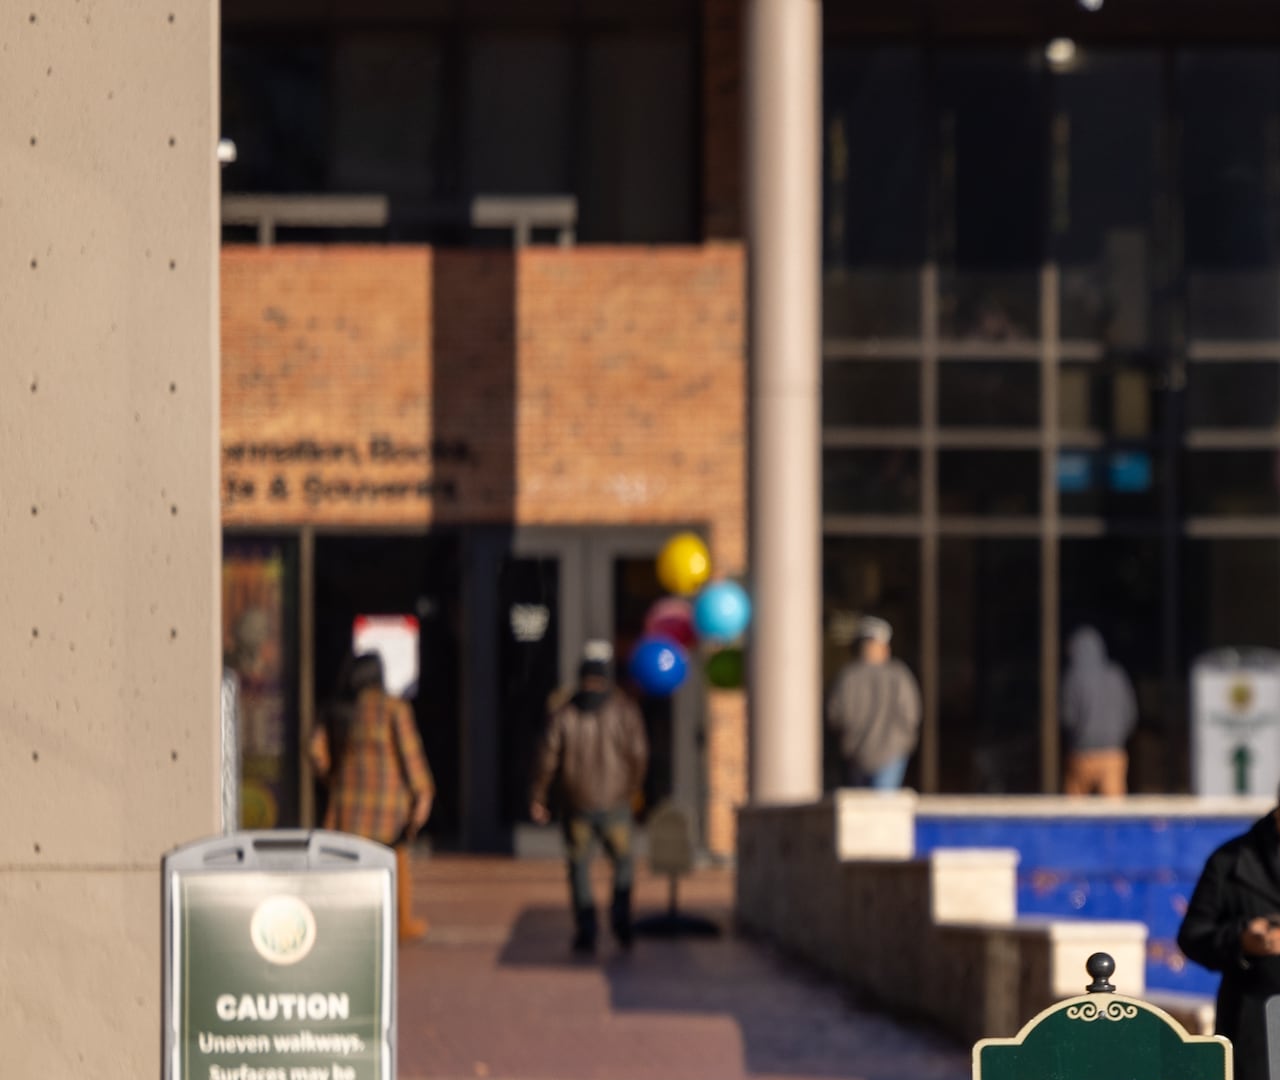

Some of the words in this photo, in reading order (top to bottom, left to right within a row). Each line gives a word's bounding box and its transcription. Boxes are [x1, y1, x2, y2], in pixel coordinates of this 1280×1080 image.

[216, 993, 350, 1021] CAUTION
[198, 1031, 271, 1054] Uneven
[272, 1030, 366, 1057] walkways.
